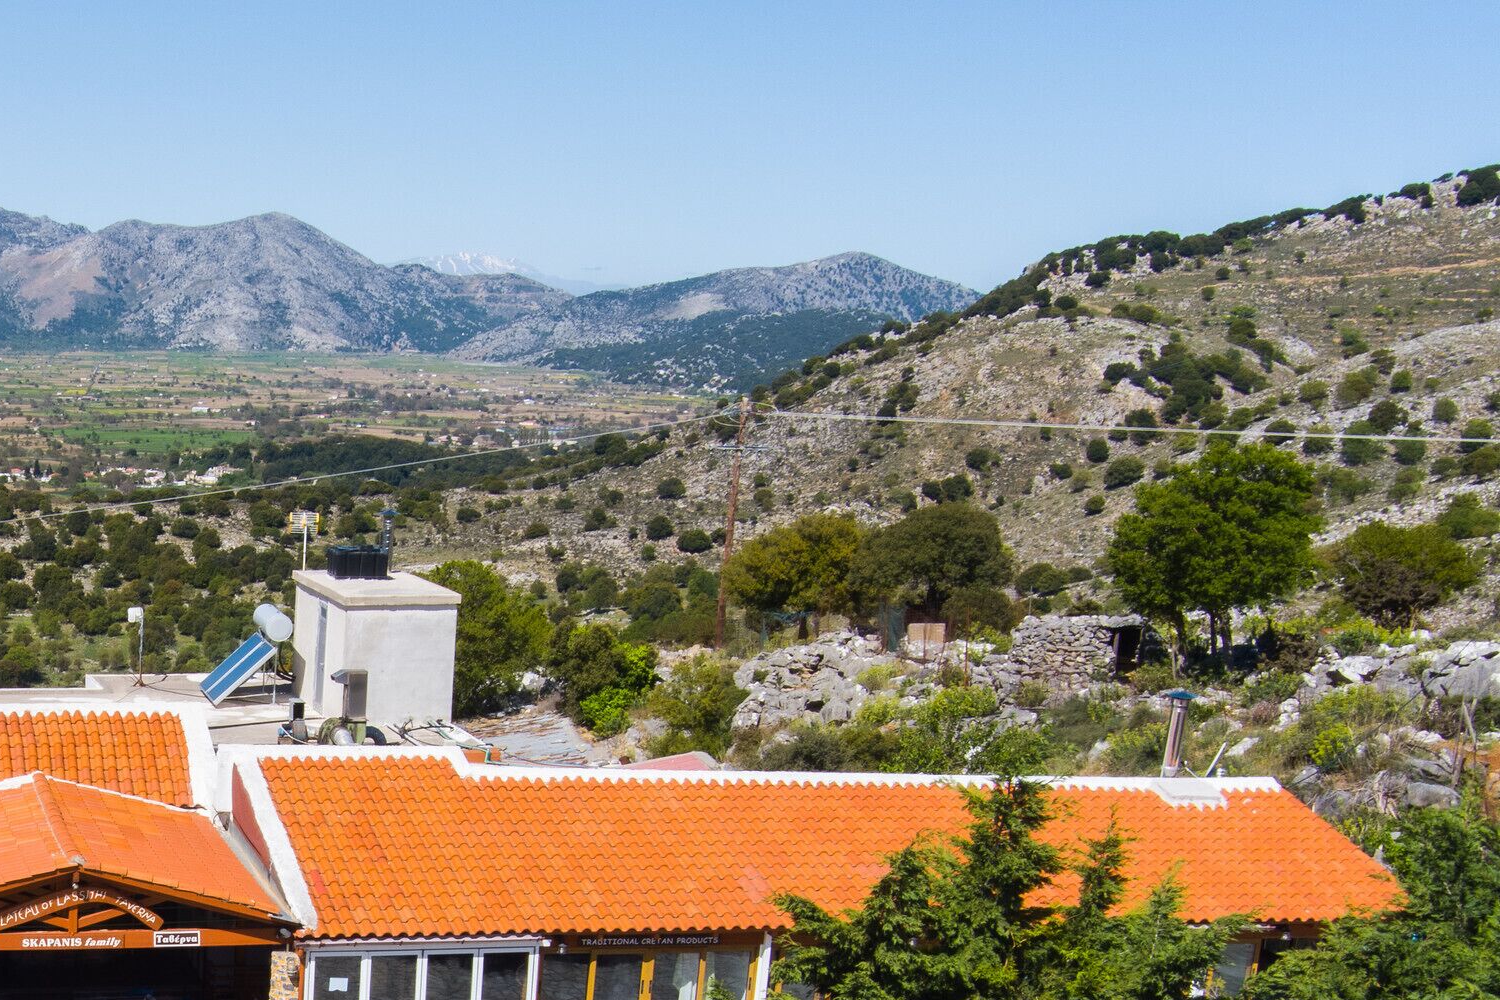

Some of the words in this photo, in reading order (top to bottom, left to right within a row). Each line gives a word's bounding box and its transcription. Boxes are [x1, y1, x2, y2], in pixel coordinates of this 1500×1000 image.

[56, 890, 107, 907] LASSITHI
[115, 896, 157, 924] TAVERNA
[22, 937, 83, 947] SKAPANIS
[84, 936, 122, 948] family
[155, 934, 198, 944] Ταβέρνα
[581, 938, 639, 946] TRADITIONAL
[641, 937, 674, 945] CRETAN
[676, 936, 719, 944] PRODUCTS
